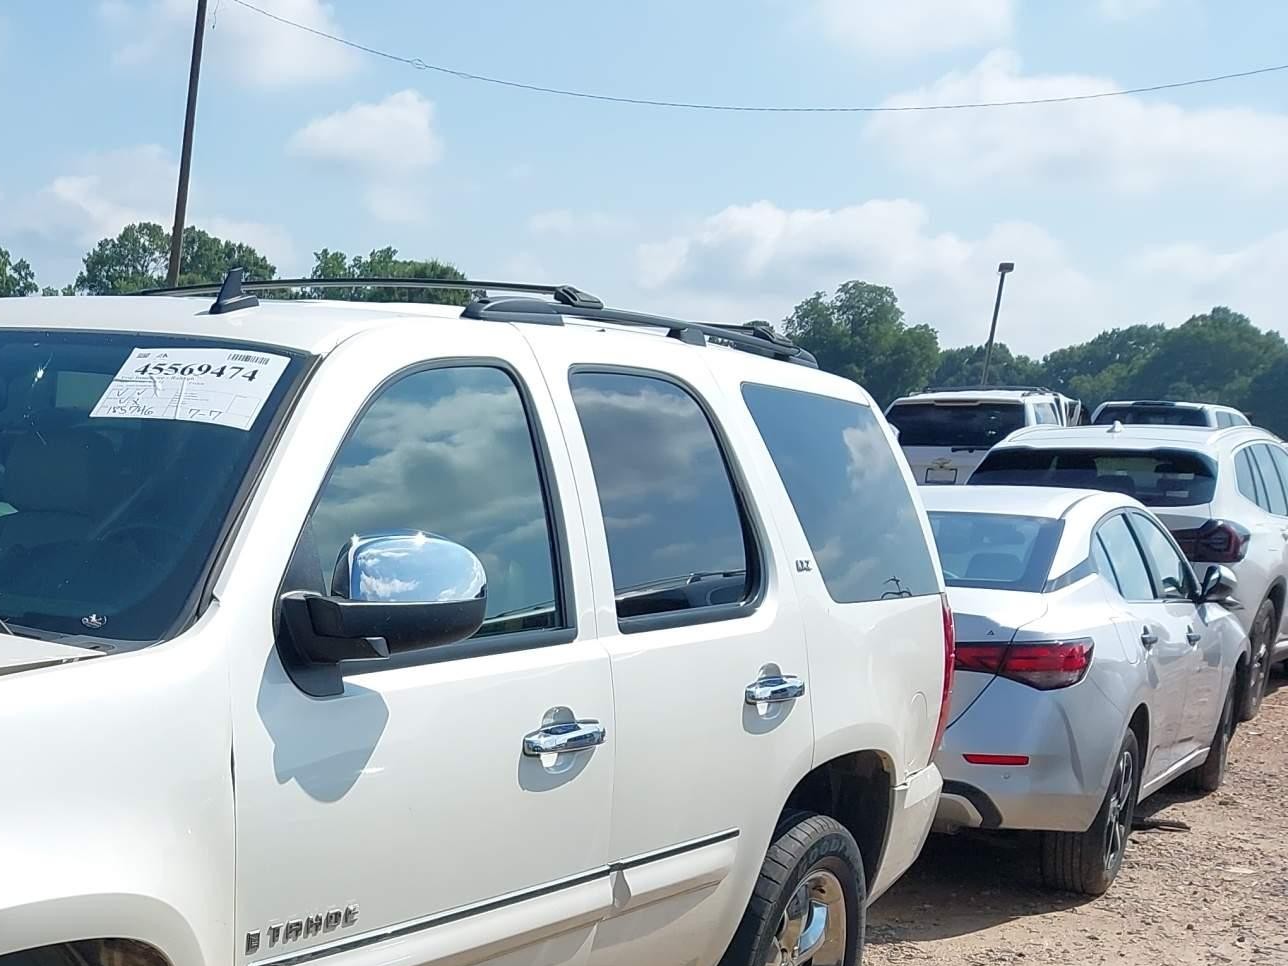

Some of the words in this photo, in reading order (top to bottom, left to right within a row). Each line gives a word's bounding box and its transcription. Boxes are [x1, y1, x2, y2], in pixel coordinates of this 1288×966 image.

[134, 362, 260, 382] 45569474
[188, 408, 224, 420] 7-7
[266, 903, 360, 947] TAHOE
